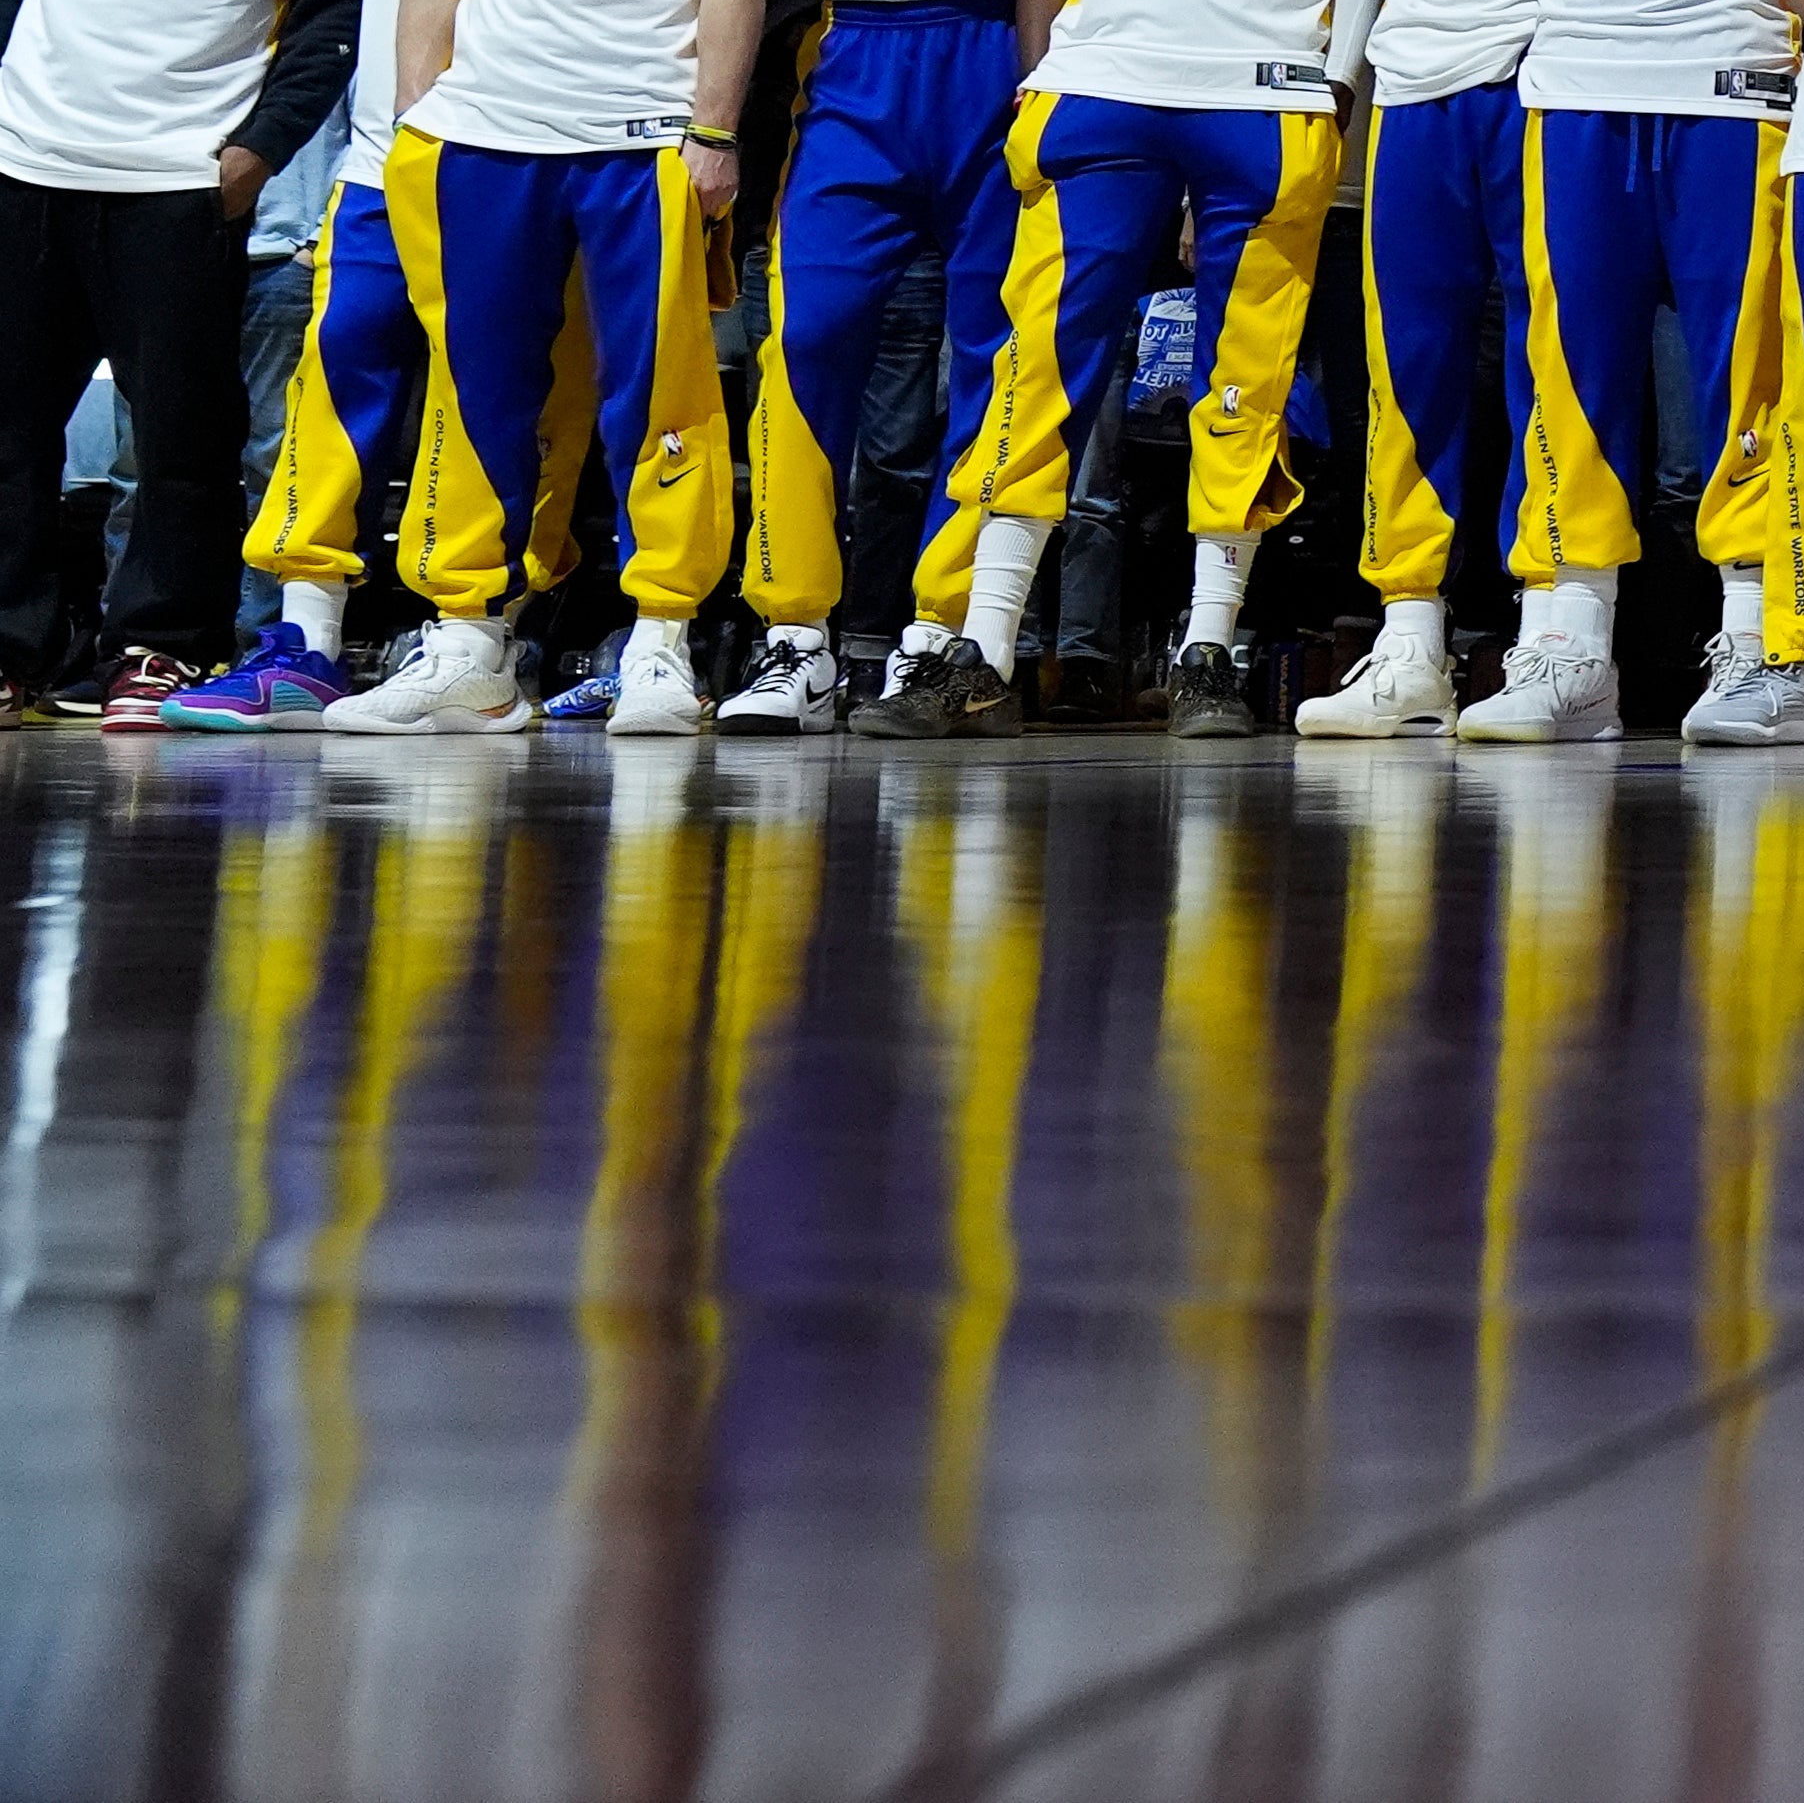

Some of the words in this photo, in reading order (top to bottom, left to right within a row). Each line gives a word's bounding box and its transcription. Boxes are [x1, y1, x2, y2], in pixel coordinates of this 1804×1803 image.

[431, 409, 444, 466] GOLDEN
[760, 398, 769, 456] GOLDEN
[1001, 391, 1013, 430] STATE
[1535, 393, 1548, 453] GOLDEN
[1546, 502, 1565, 565] WARRIO
[1781, 422, 1796, 483] GOLDEN
[427, 469, 439, 509] STATE
[1788, 487, 1800, 530] STATE
[417, 516, 435, 581] WARRIOR
[759, 509, 773, 583] WARRIORS
